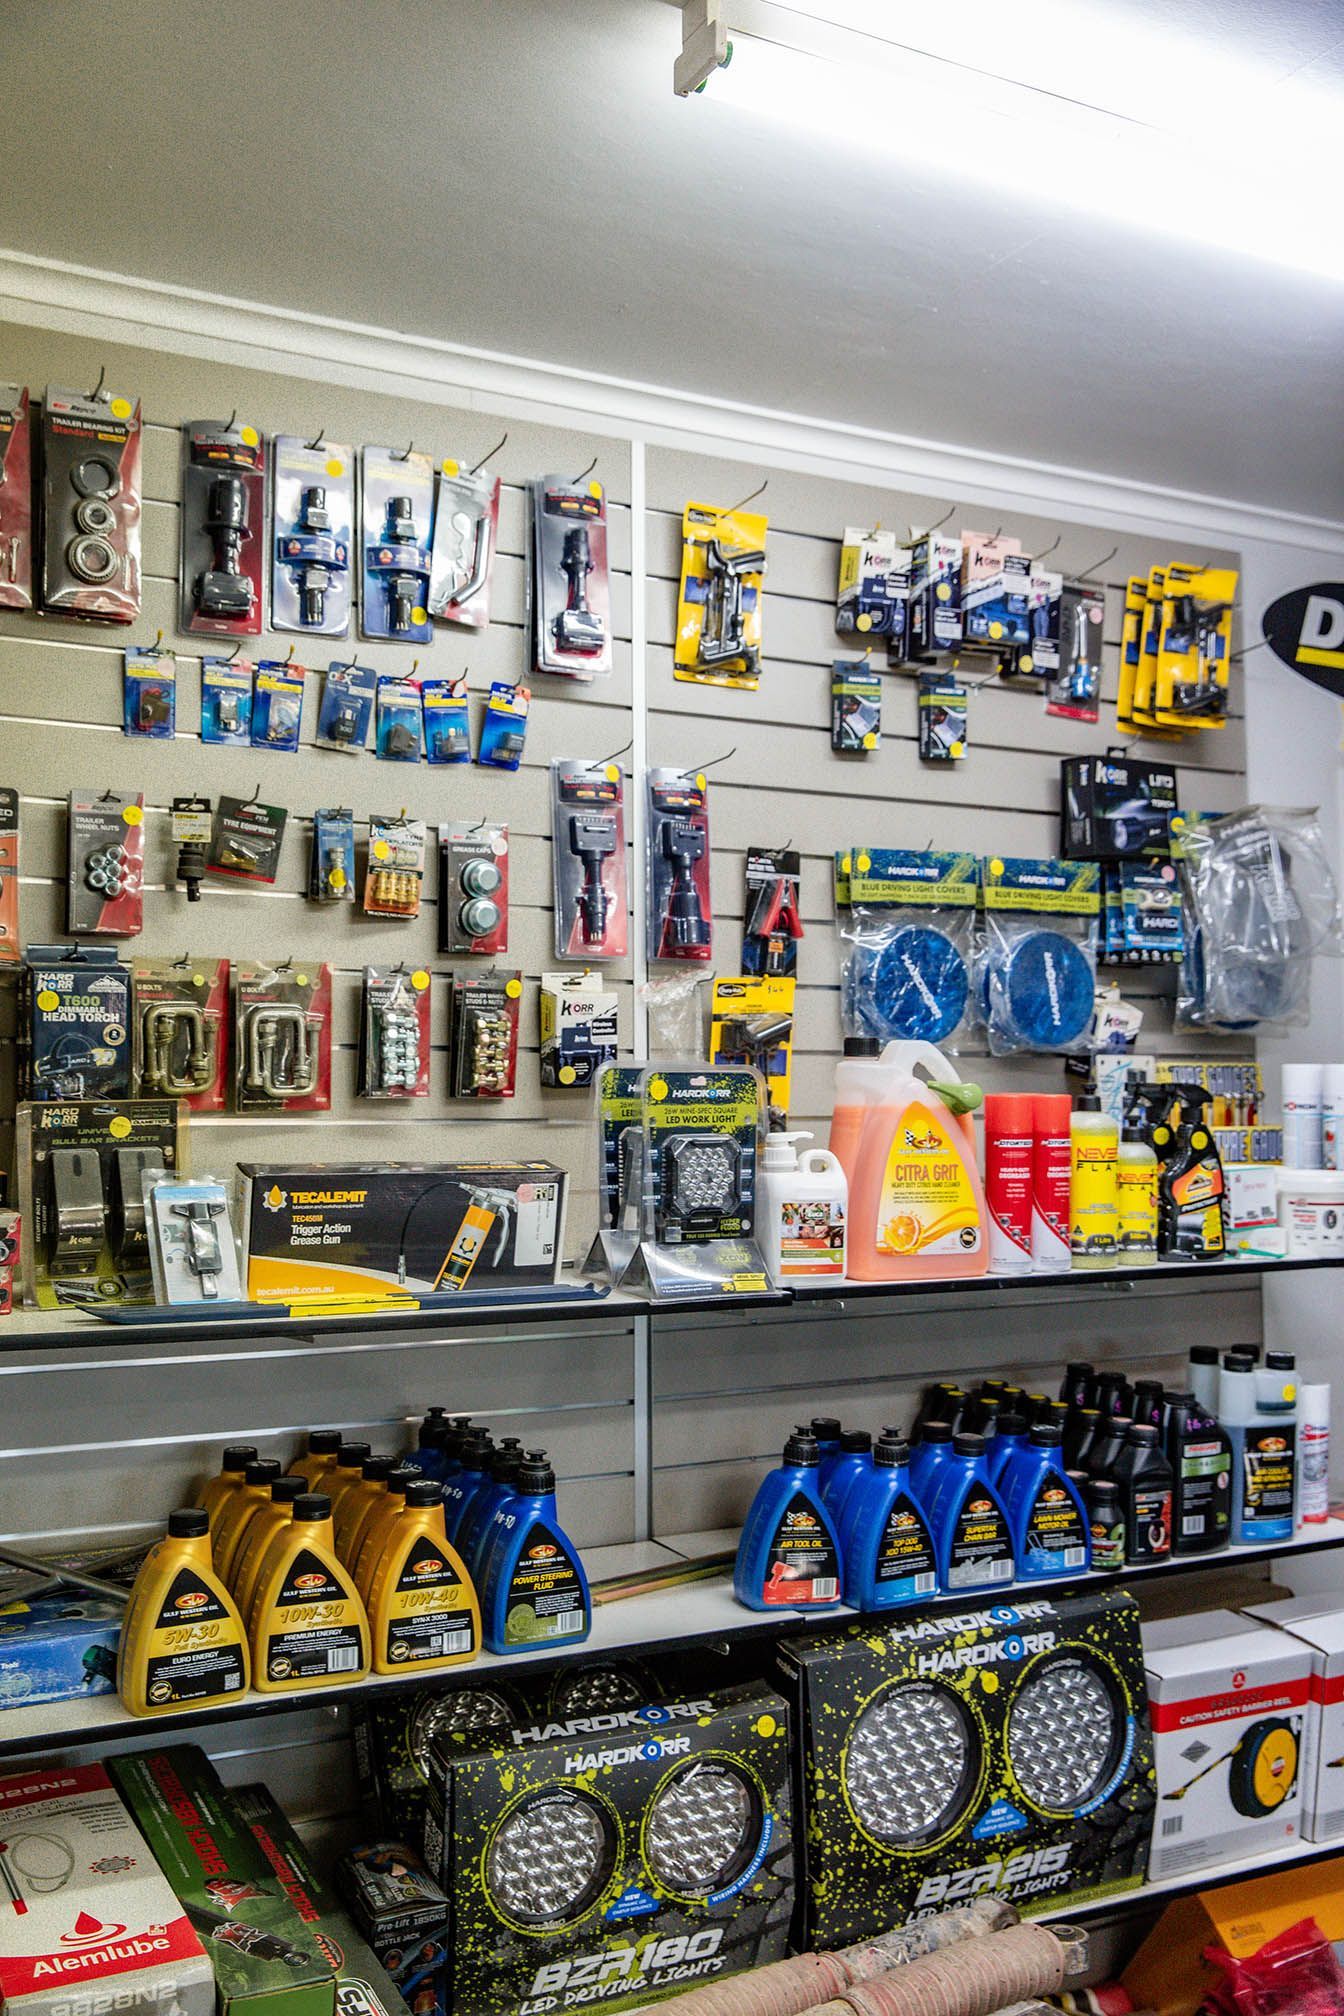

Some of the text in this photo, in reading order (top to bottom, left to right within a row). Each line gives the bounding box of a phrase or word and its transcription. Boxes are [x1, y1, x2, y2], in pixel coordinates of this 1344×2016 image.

[51, 416, 127, 436] TRAILER BEARING KIT
[52, 425, 95, 440] Standard
[75, 816, 105, 825] TRAILER
[75, 824, 121, 833] WHEEL NUTS
[862, 883, 967, 895] BLUE DRIVING LIGHT COVERS
[63, 994, 101, 1007] T600
[58, 1005, 106, 1014] DIMMABLE
[43, 1012, 120, 1023] HEAD TORCH
[672, 1088, 731, 1099] HARDKORR
[43, 1107, 79, 1117] HARD
[713, 1106, 738, 1114] SQUARE
[666, 1114, 737, 1124] LED WORK LIGHT
[895, 1163, 959, 1181] CITRA GRIT
[290, 1190, 368, 1204] TECALEMIT
[290, 1223, 352, 1237] Trigger Action
[290, 1234, 341, 1246] Grease Gun
[256, 1286, 336, 1297] tecalemit.com.au
[781, 1540, 823, 1548] AIR TOOL OIL
[512, 1570, 574, 1586] POWER STEERING
[533, 1581, 555, 1591] FLUID
[280, 1602, 345, 1624] 10W-30
[890, 1600, 1059, 1645] HARDKORR
[163, 1622, 221, 1646] 5W-30
[284, 1628, 343, 1642] PREMIUM ENERGY
[172, 1650, 220, 1665] EURO ENERGY
[917, 1631, 1058, 1676] HARDKORR
[511, 1699, 718, 1746] HARDKORR
[1180, 1711, 1214, 1726] CAUTION
[564, 1736, 692, 1775] HARDKORR
[711, 1818, 773, 1902] WIRING HARNESS INCLUDED
[1012, 1869, 1073, 1899] LIGHTS
[624, 1892, 641, 1902] NEW
[376, 1911, 447, 1933] Pro-Lift 1850KG
[374, 1931, 421, 1948] BOTTLE JACK
[32, 1934, 171, 1979] Alemlube
[519, 1954, 728, 2016] LED DRIVING LIGHTS
